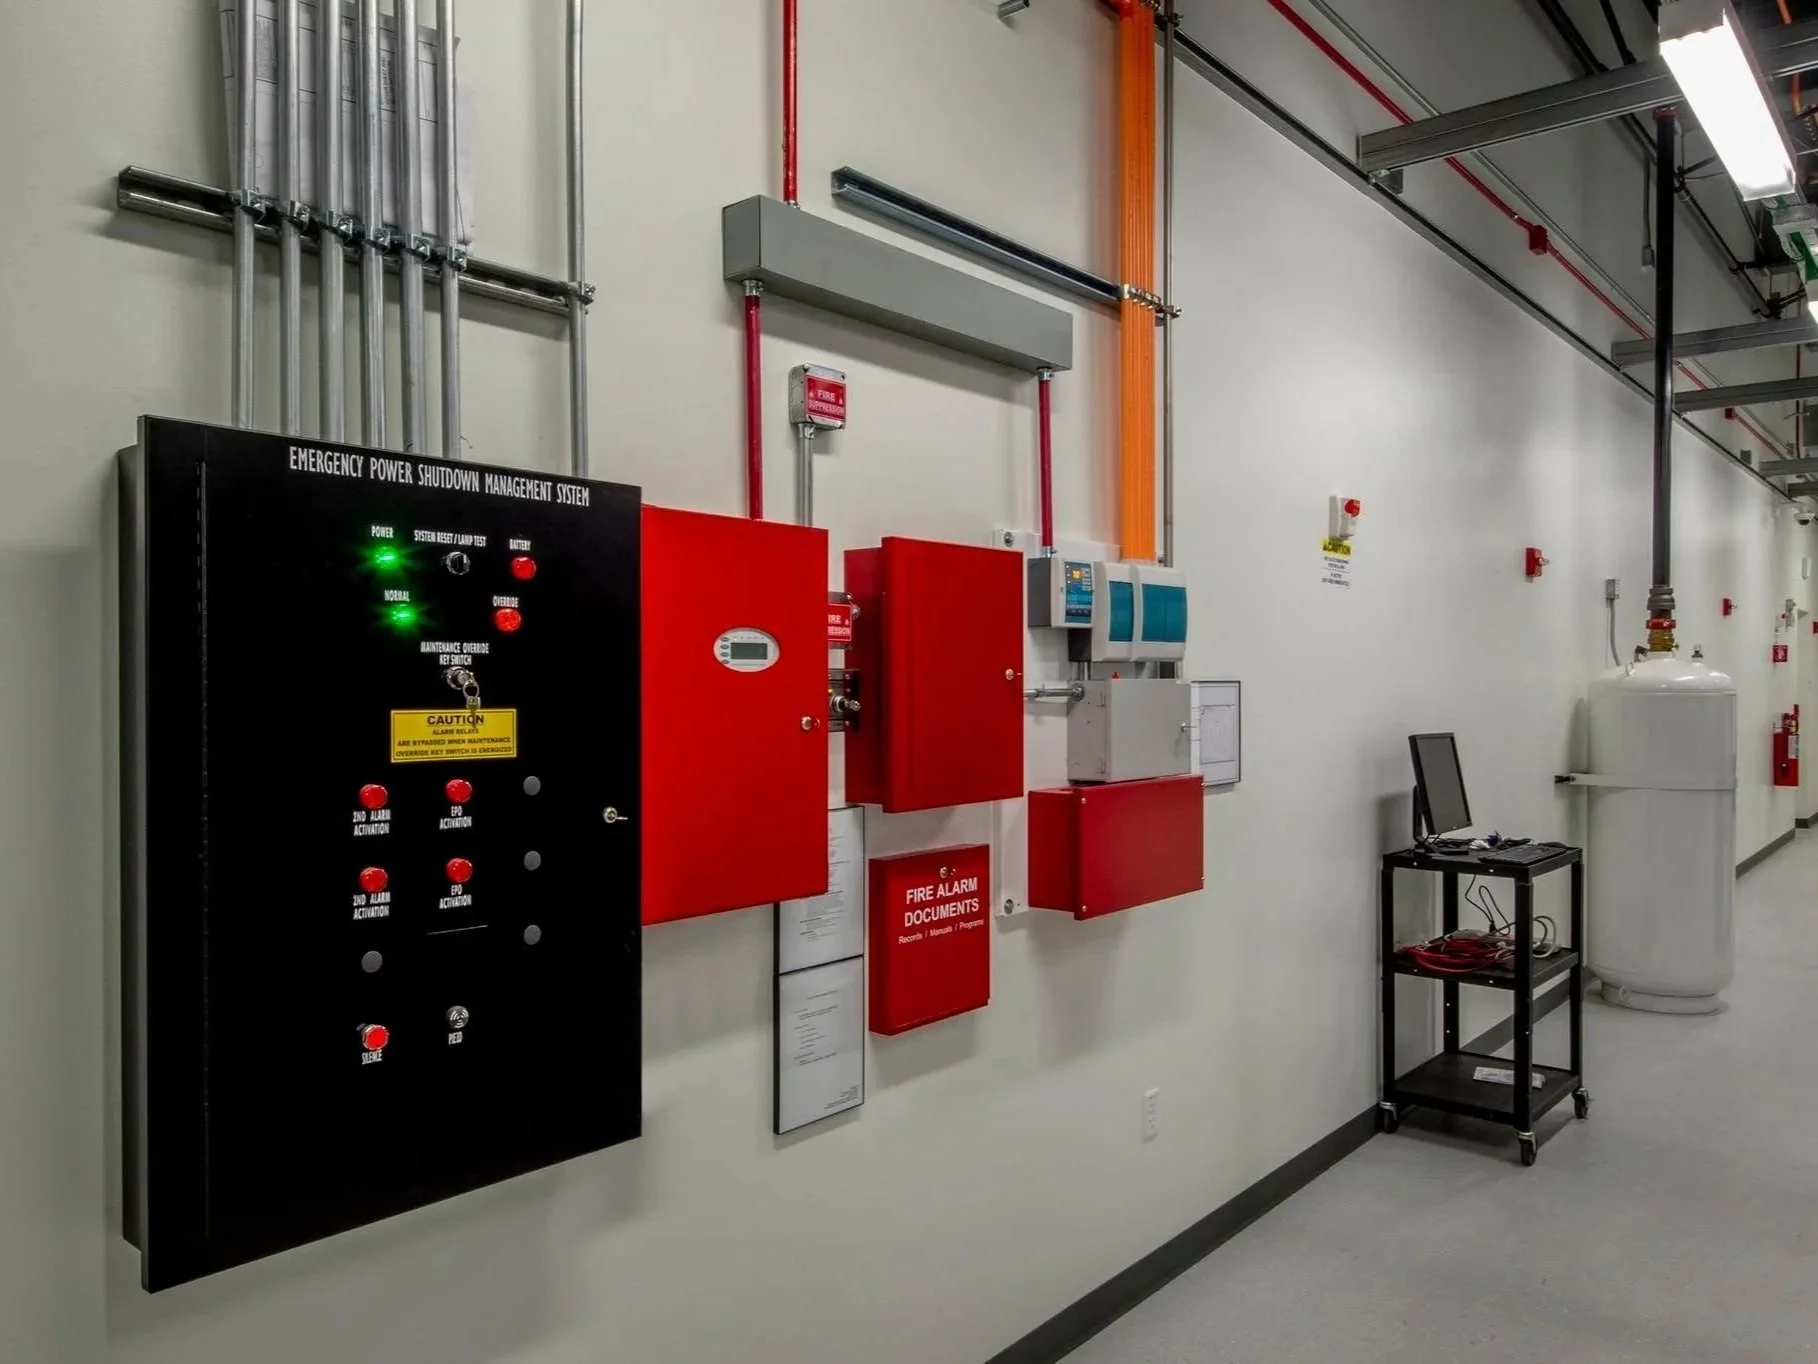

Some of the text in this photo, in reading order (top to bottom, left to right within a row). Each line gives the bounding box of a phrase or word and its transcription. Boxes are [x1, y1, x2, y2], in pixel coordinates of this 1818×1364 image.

[817, 389, 837, 403] FIRE
[289, 446, 590, 507] EMERGENCY POWER SHUTDOWN MANAGEMENT SYSTEM
[371, 525, 394, 540] POWER
[414, 530, 437, 543] SYSTEM
[437, 531, 453, 544] RESET
[458, 534, 473, 546] LAMP
[474, 535, 487, 547] TEST
[509, 538, 531, 551] BATTERY
[384, 589, 410, 602] NORMAL
[492, 595, 519, 608] OVERRIDE
[828, 614, 841, 625] IRE
[420, 641, 489, 654] MAINTENANCE OVERRIDE
[439, 654, 472, 665] KEY SWITCH
[427, 714, 485, 725] CAUTION
[432, 727, 479, 736] ALARM RELAYS
[468, 736, 511, 744] MAINTENANCE
[396, 749, 429, 757] OVERRIDE
[353, 809, 391, 823] 2ND ALARM
[451, 805, 462, 816] EPO
[353, 822, 390, 836] ACTIVATION
[439, 816, 472, 830] ACTIVATION
[451, 884, 462, 896] EPO
[906, 877, 978, 905] FIRE ALARM
[353, 891, 391, 906] 2ND ALARM
[439, 894, 472, 909] ACTIVATION
[353, 905, 390, 920] ACTIVATION
[904, 898, 979, 927] DOCUMENTS
[898, 932, 923, 944] Records
[929, 925, 953, 937] Manuals
[959, 919, 984, 930] Programs
[361, 1050, 382, 1065] SILENCE
